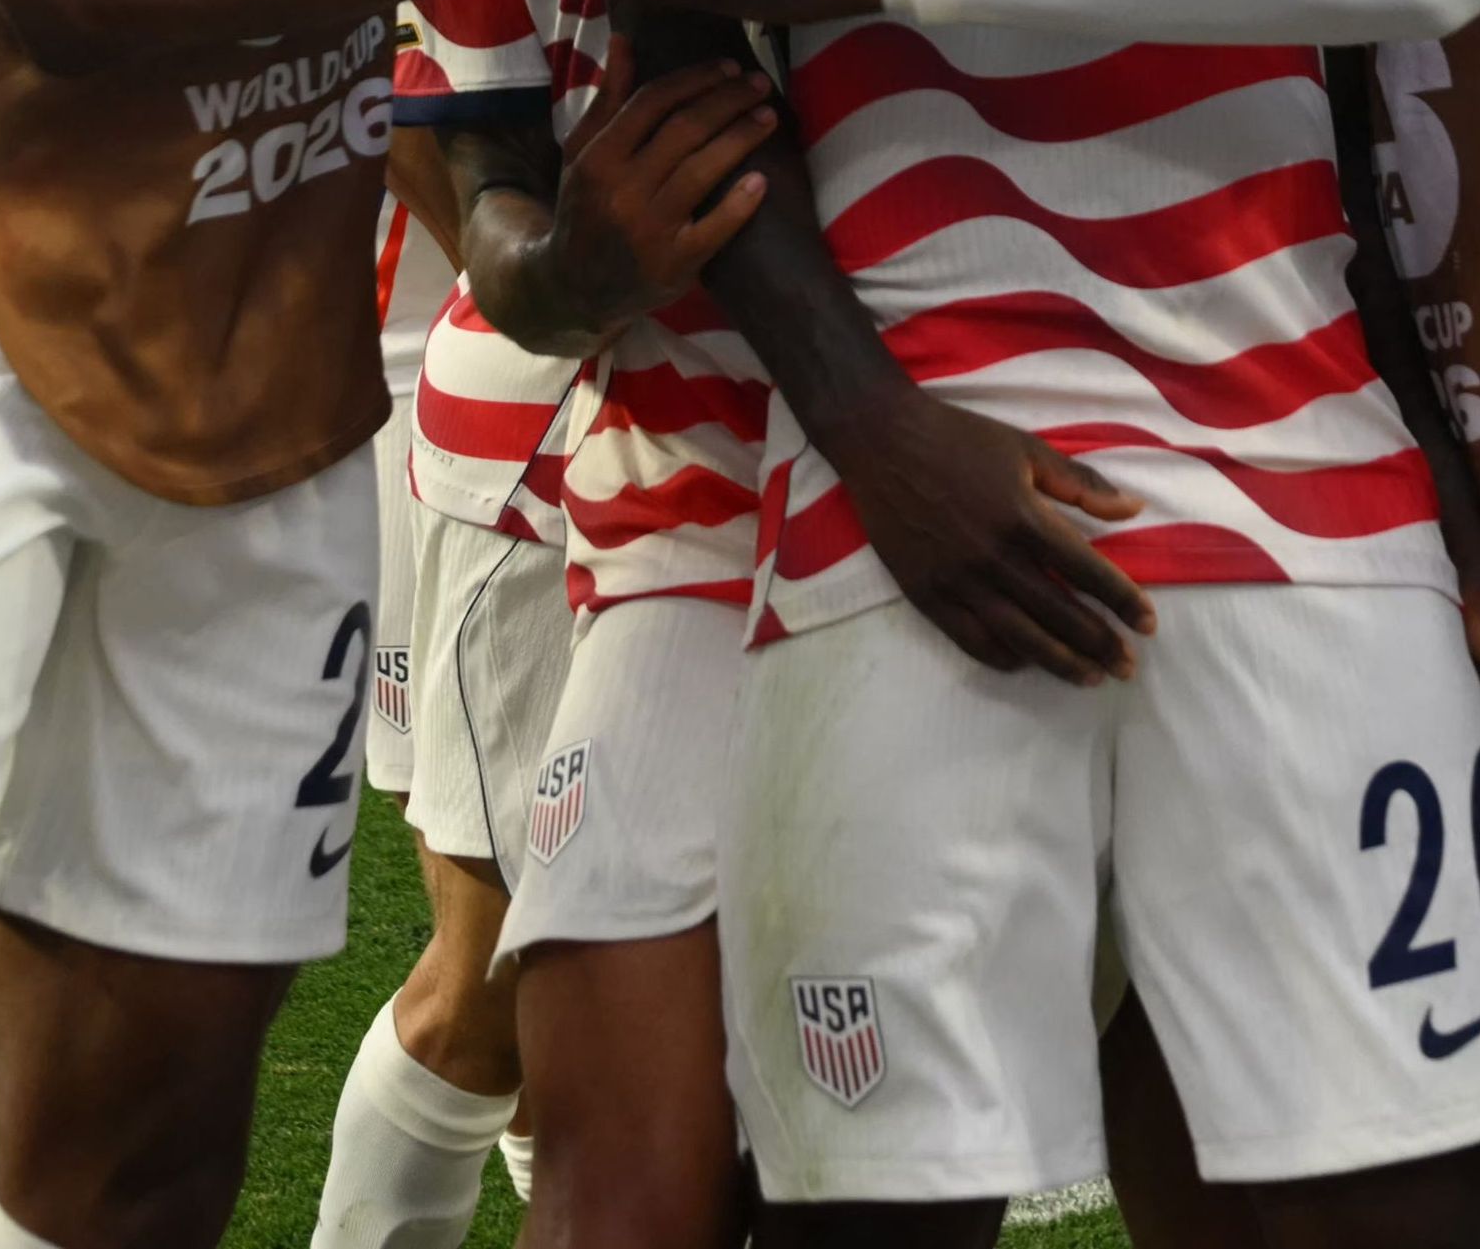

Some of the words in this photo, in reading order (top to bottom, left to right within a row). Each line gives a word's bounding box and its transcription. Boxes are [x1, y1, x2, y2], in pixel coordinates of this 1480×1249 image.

[183, 50, 341, 133] WORLD
[340, 15, 386, 80] CUP
[186, 76, 394, 227] 2026
[1414, 300, 1473, 351] CUP
[376, 651, 409, 683] US
[537, 748, 585, 800] USA
[799, 983, 872, 1033] USA
